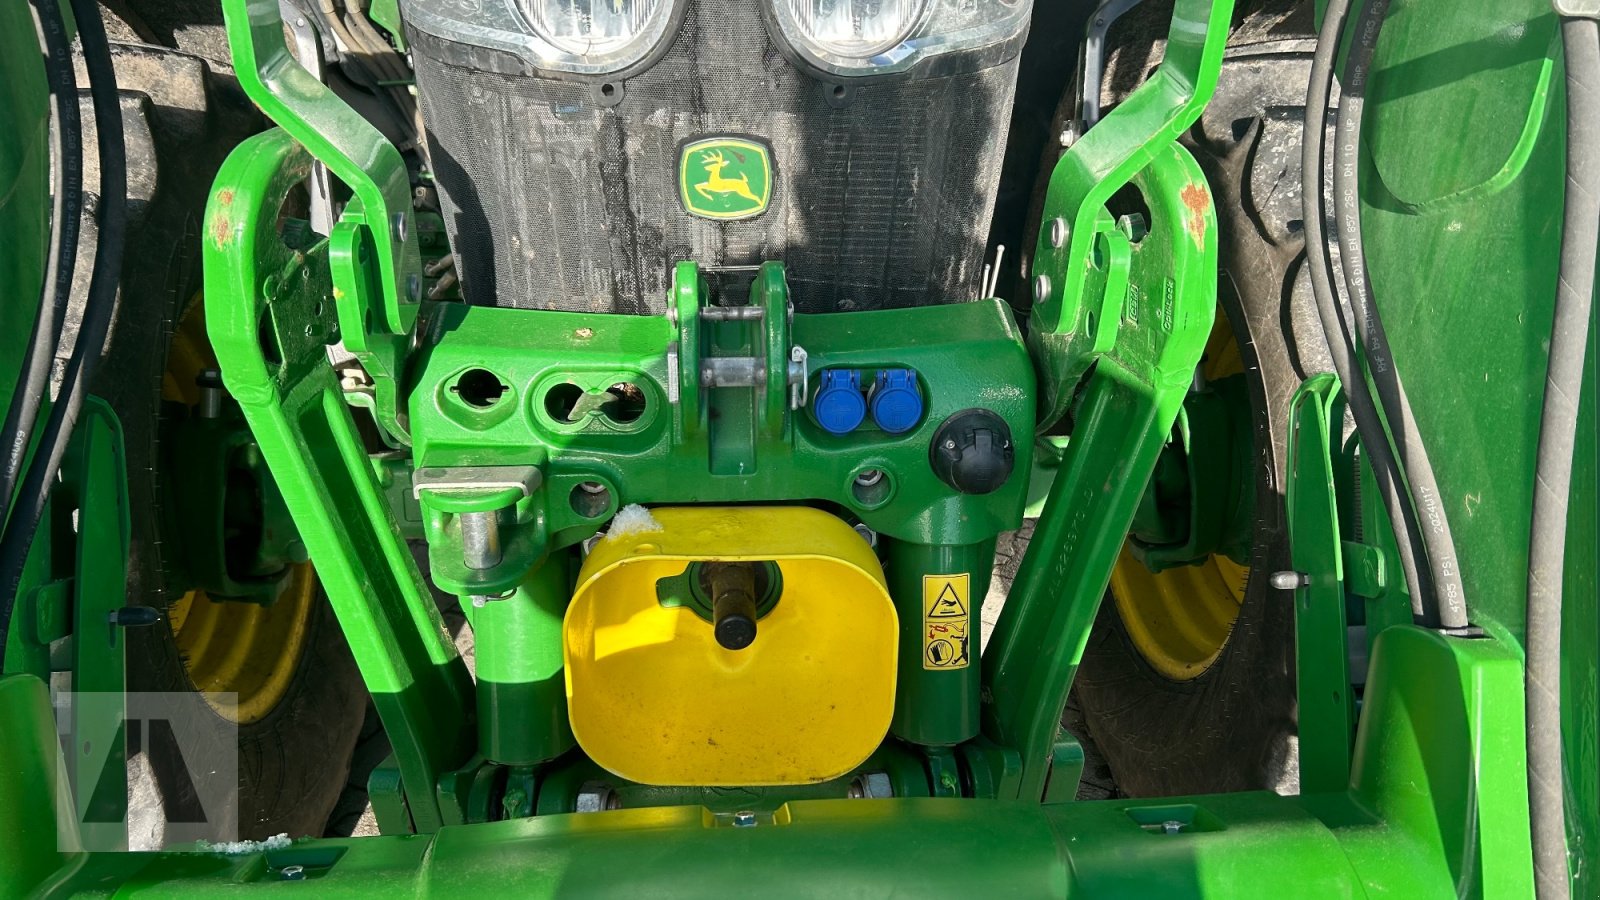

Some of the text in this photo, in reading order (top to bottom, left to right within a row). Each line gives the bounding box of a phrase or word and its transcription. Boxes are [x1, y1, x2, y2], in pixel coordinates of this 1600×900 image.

[1352, 65, 1361, 86] BAR
[1349, 92, 1359, 112] 330
[1344, 144, 1354, 157] 10
[68, 156, 77, 171] EN
[1344, 163, 1353, 177] DN
[1344, 189, 1354, 208] 2SC
[1345, 215, 1356, 233] 857
[1349, 238, 1358, 251] EN
[1371, 338, 1380, 351] by
[1442, 556, 1453, 577] PSI
[1446, 583, 1460, 613] 4785
